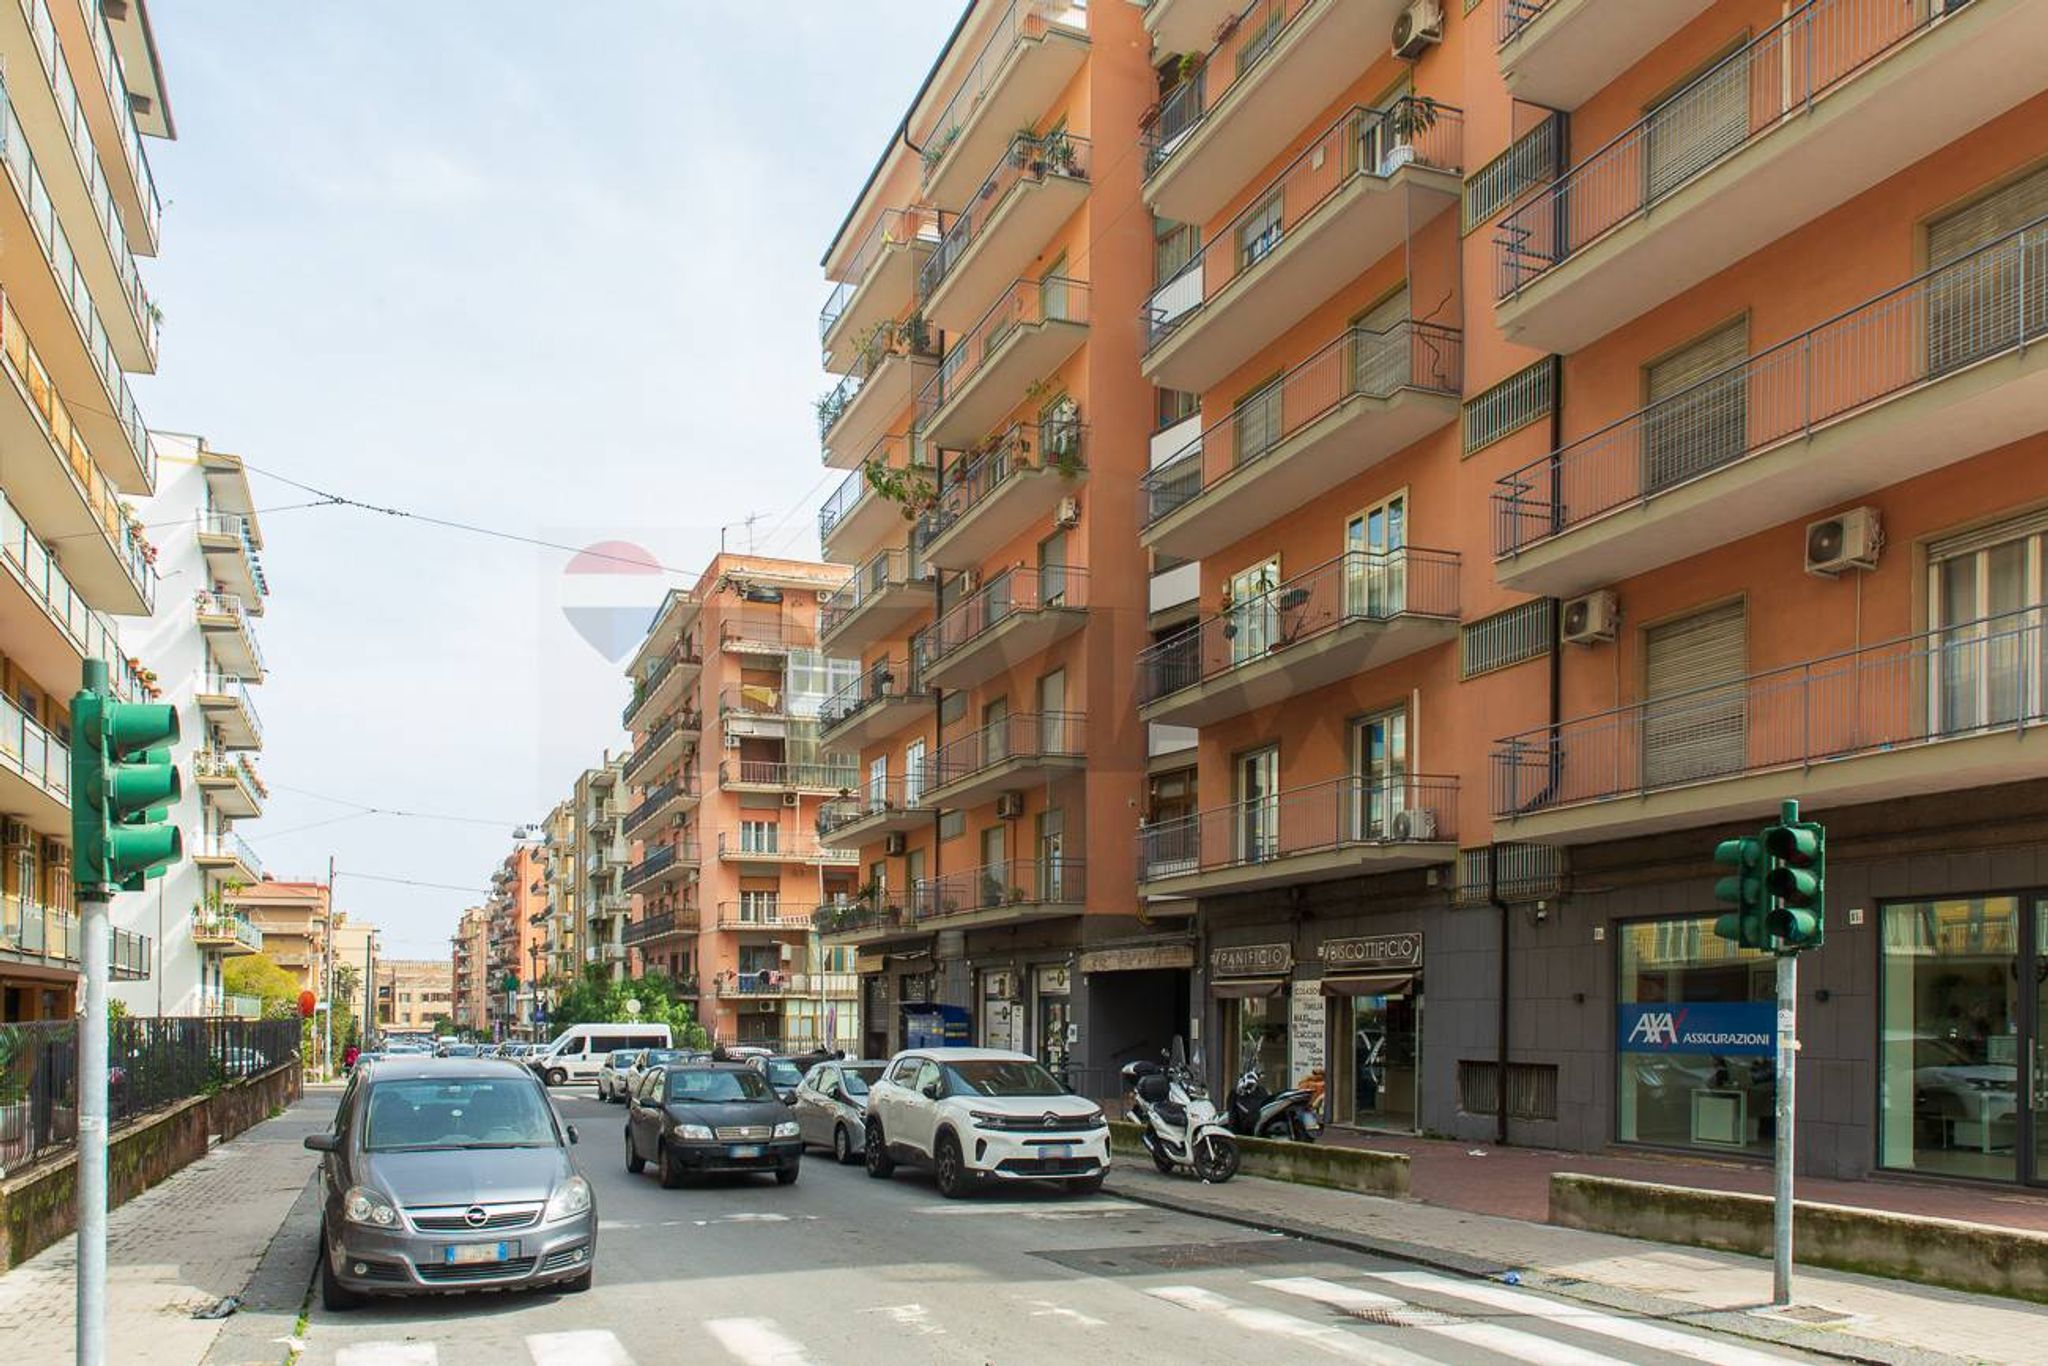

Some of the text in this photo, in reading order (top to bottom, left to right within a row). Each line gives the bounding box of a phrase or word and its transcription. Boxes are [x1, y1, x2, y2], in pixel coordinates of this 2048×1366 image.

[1221, 949, 1282, 964] PANIFICIO
[1330, 940, 1412, 961] BISCOTTIFICIO
[1629, 1012, 1770, 1045] AXA ASSICURAZIONI
